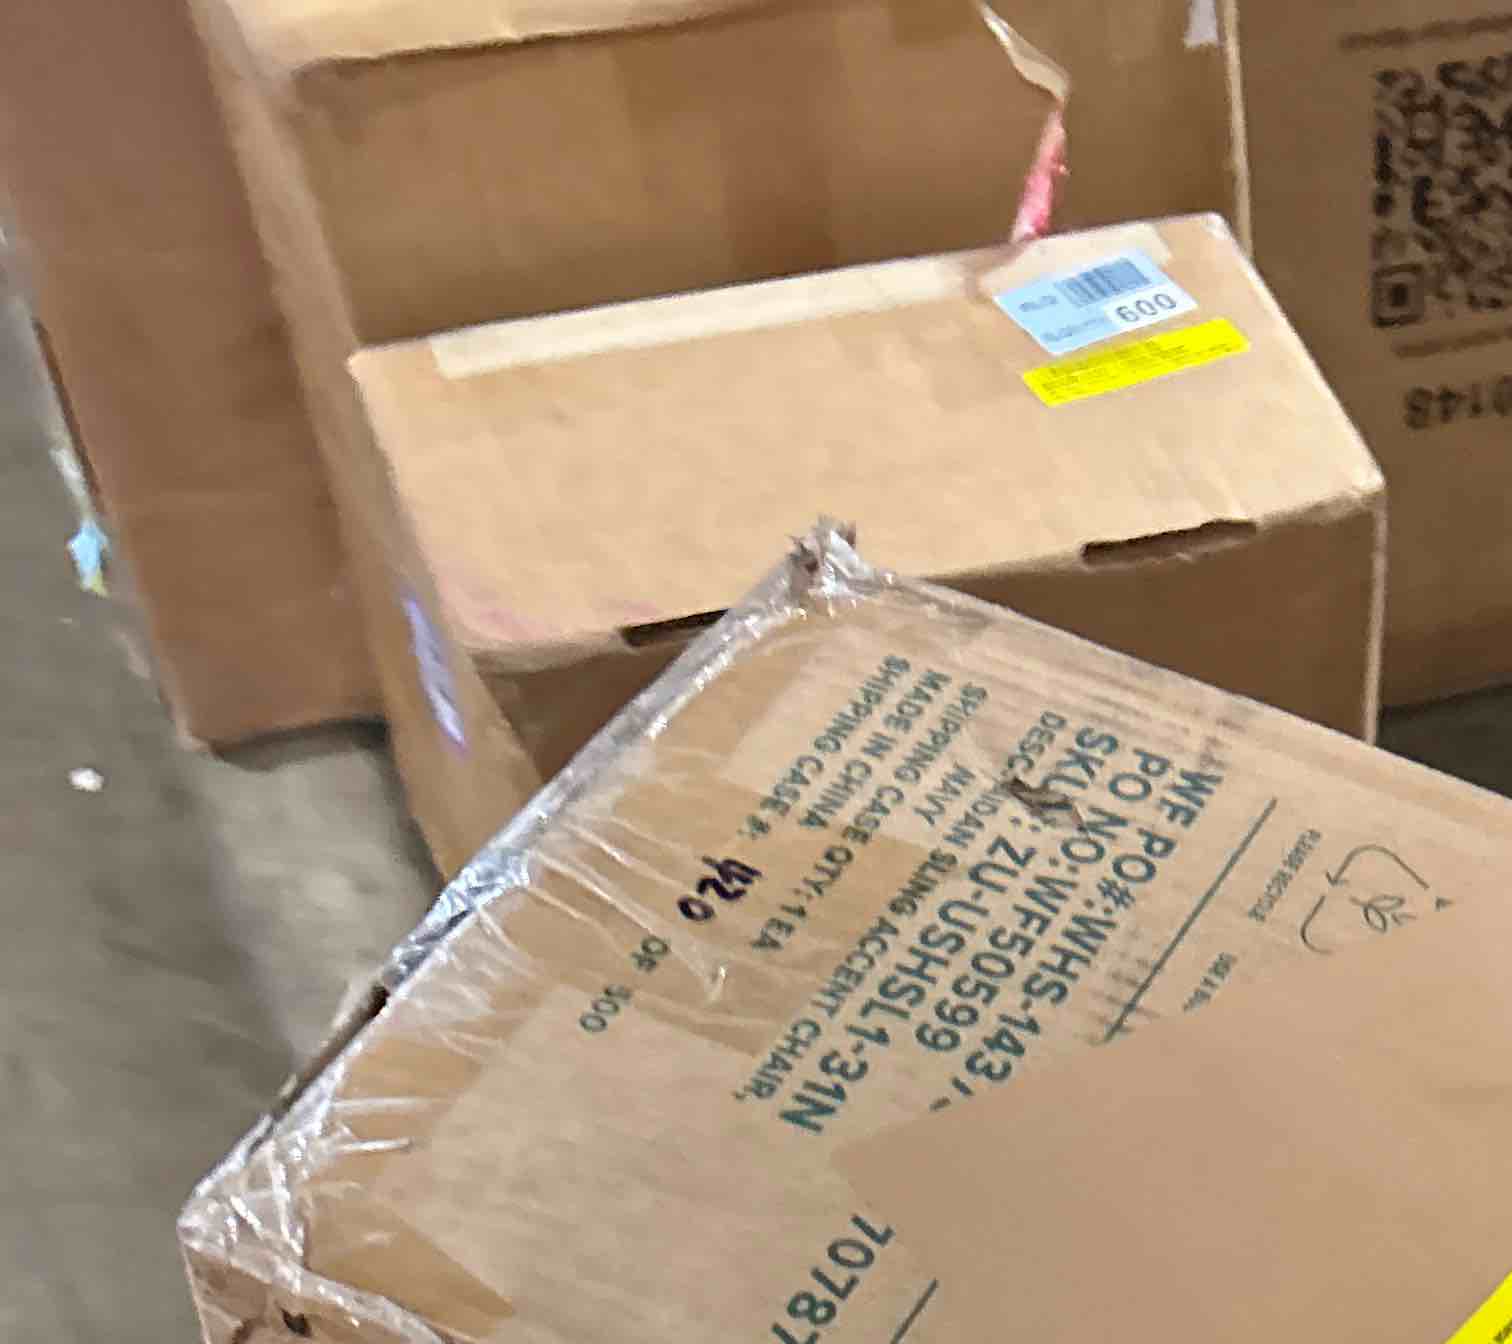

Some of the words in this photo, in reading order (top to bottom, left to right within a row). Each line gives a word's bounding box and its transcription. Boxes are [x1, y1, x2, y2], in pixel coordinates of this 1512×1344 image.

[814, 655, 911, 754] SHIPPING
[884, 669, 952, 733] MADE
[894, 682, 987, 785] SHIPPING
[862, 731, 898, 760] IN
[1109, 749, 1171, 801] PO
[760, 755, 824, 817] CASE
[799, 759, 872, 829] CHINA
[842, 785, 905, 845] CASE
[913, 760, 976, 826] NAVY
[1160, 768, 1223, 828] WF
[677, 855, 763, 921] 420
[888, 848, 958, 917] SLING
[914, 805, 1129, 1053] NO:WF50599
[778, 834, 1037, 1132] ZU-USHSL1-31N
[810, 915, 899, 1018] ACCENT
[930, 829, 1177, 1112] PO#:WHS-143
[733, 1018, 821, 1101] CHAIR,
